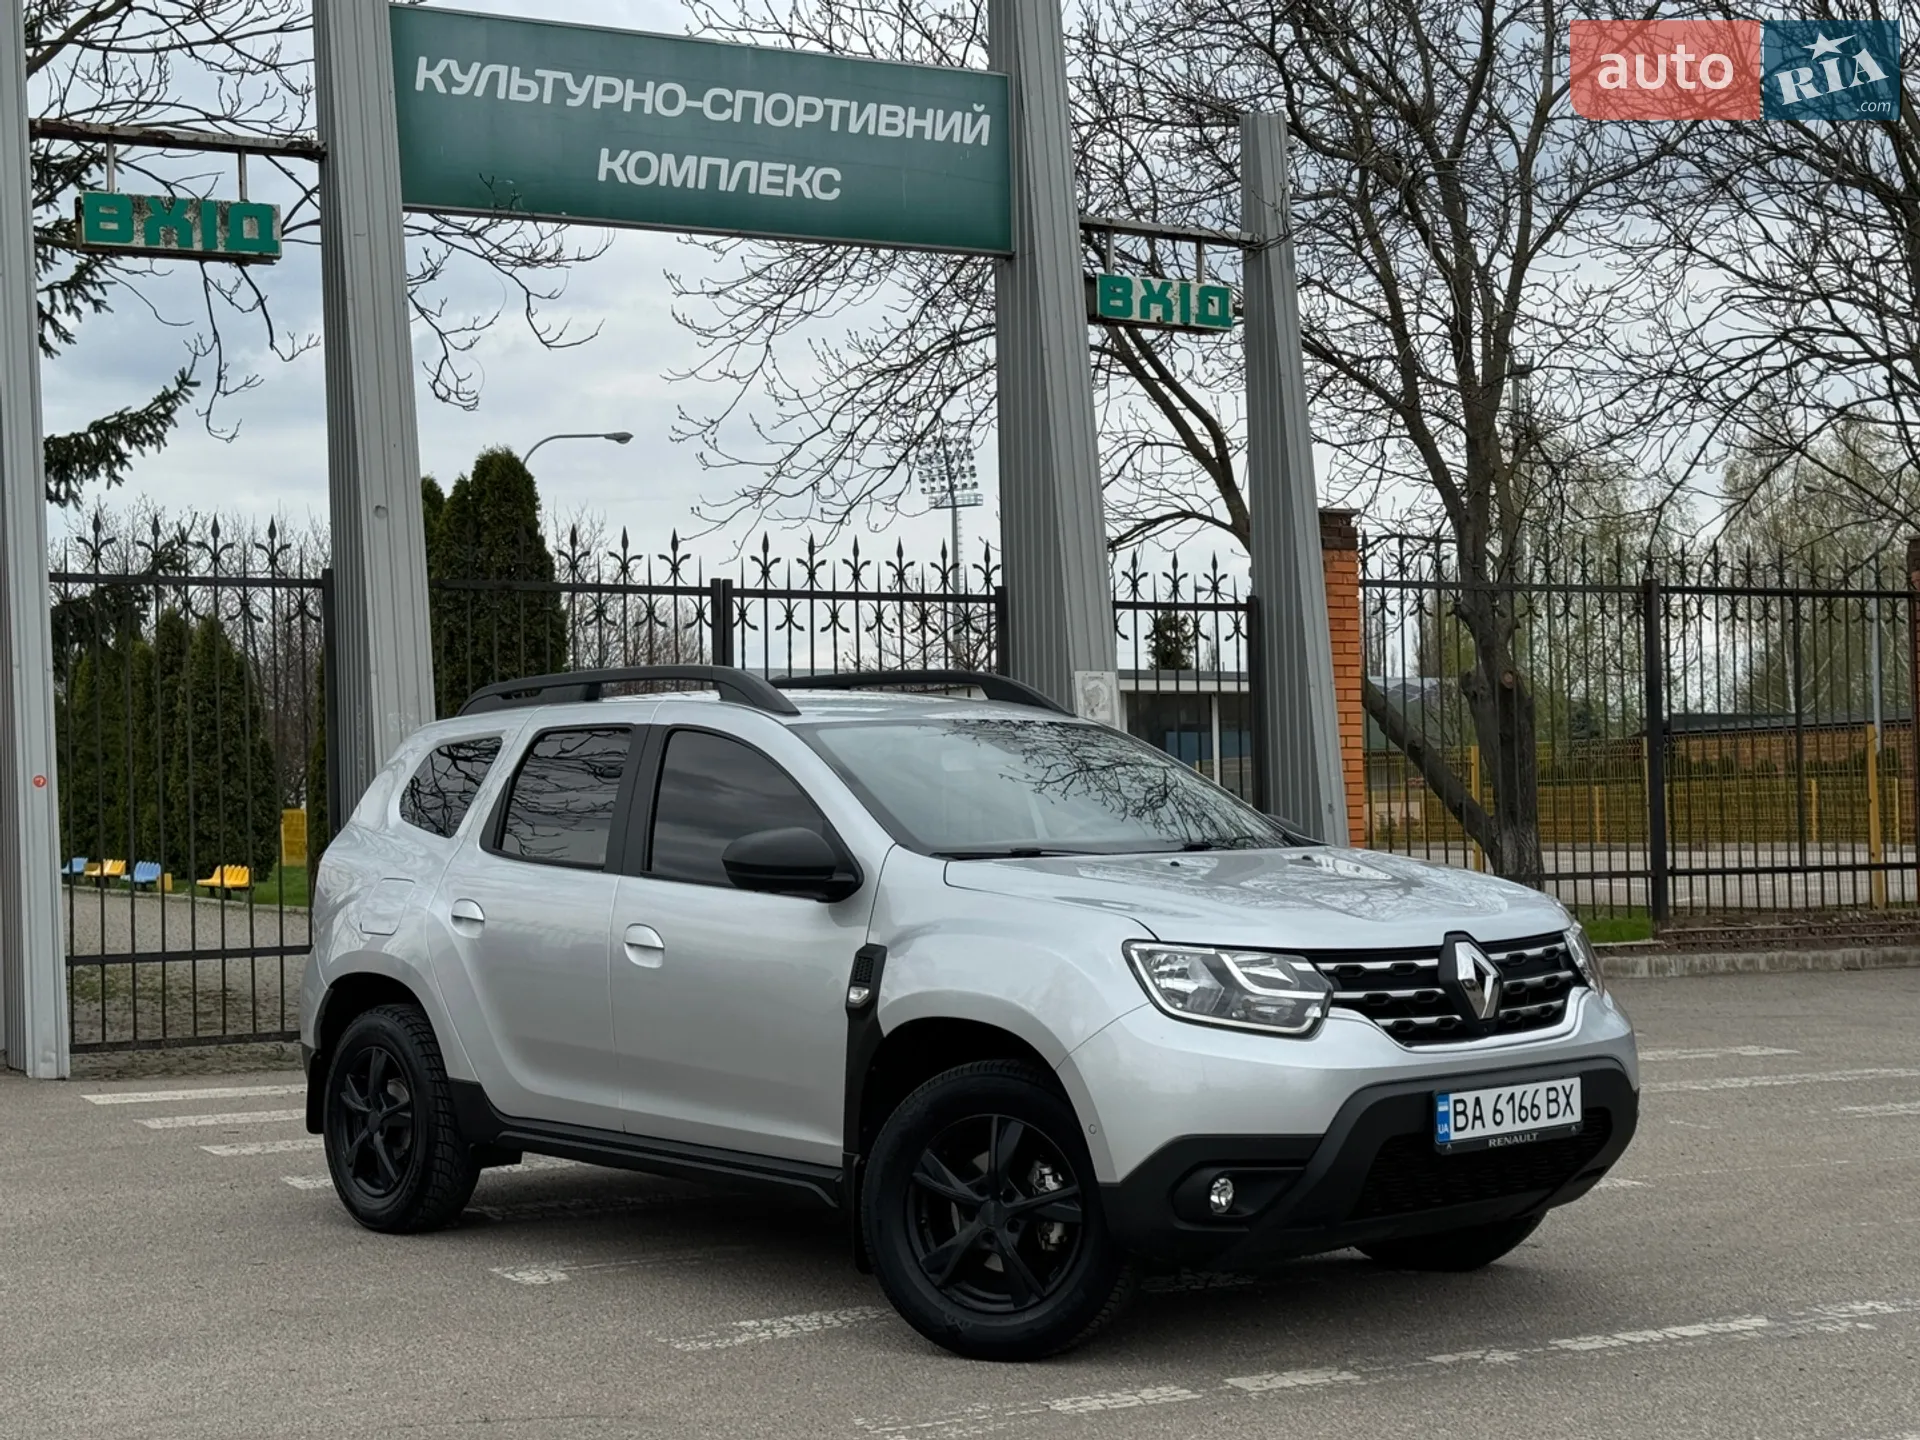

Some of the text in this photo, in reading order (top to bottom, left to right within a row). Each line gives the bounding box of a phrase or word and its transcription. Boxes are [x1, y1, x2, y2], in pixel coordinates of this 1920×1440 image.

[414, 57, 990, 145] КУЛЬТУРНО-СПОРТИВНИЙ
[597, 148, 841, 201] КОМПЛЕКС
[83, 192, 279, 253] ВХІД
[1099, 274, 1233, 327] ВХІД
[1437, 1124, 1449, 1134] UA
[1453, 1083, 1575, 1132] BA 6166 BX
[1488, 1132, 1538, 1147] RENAULT
